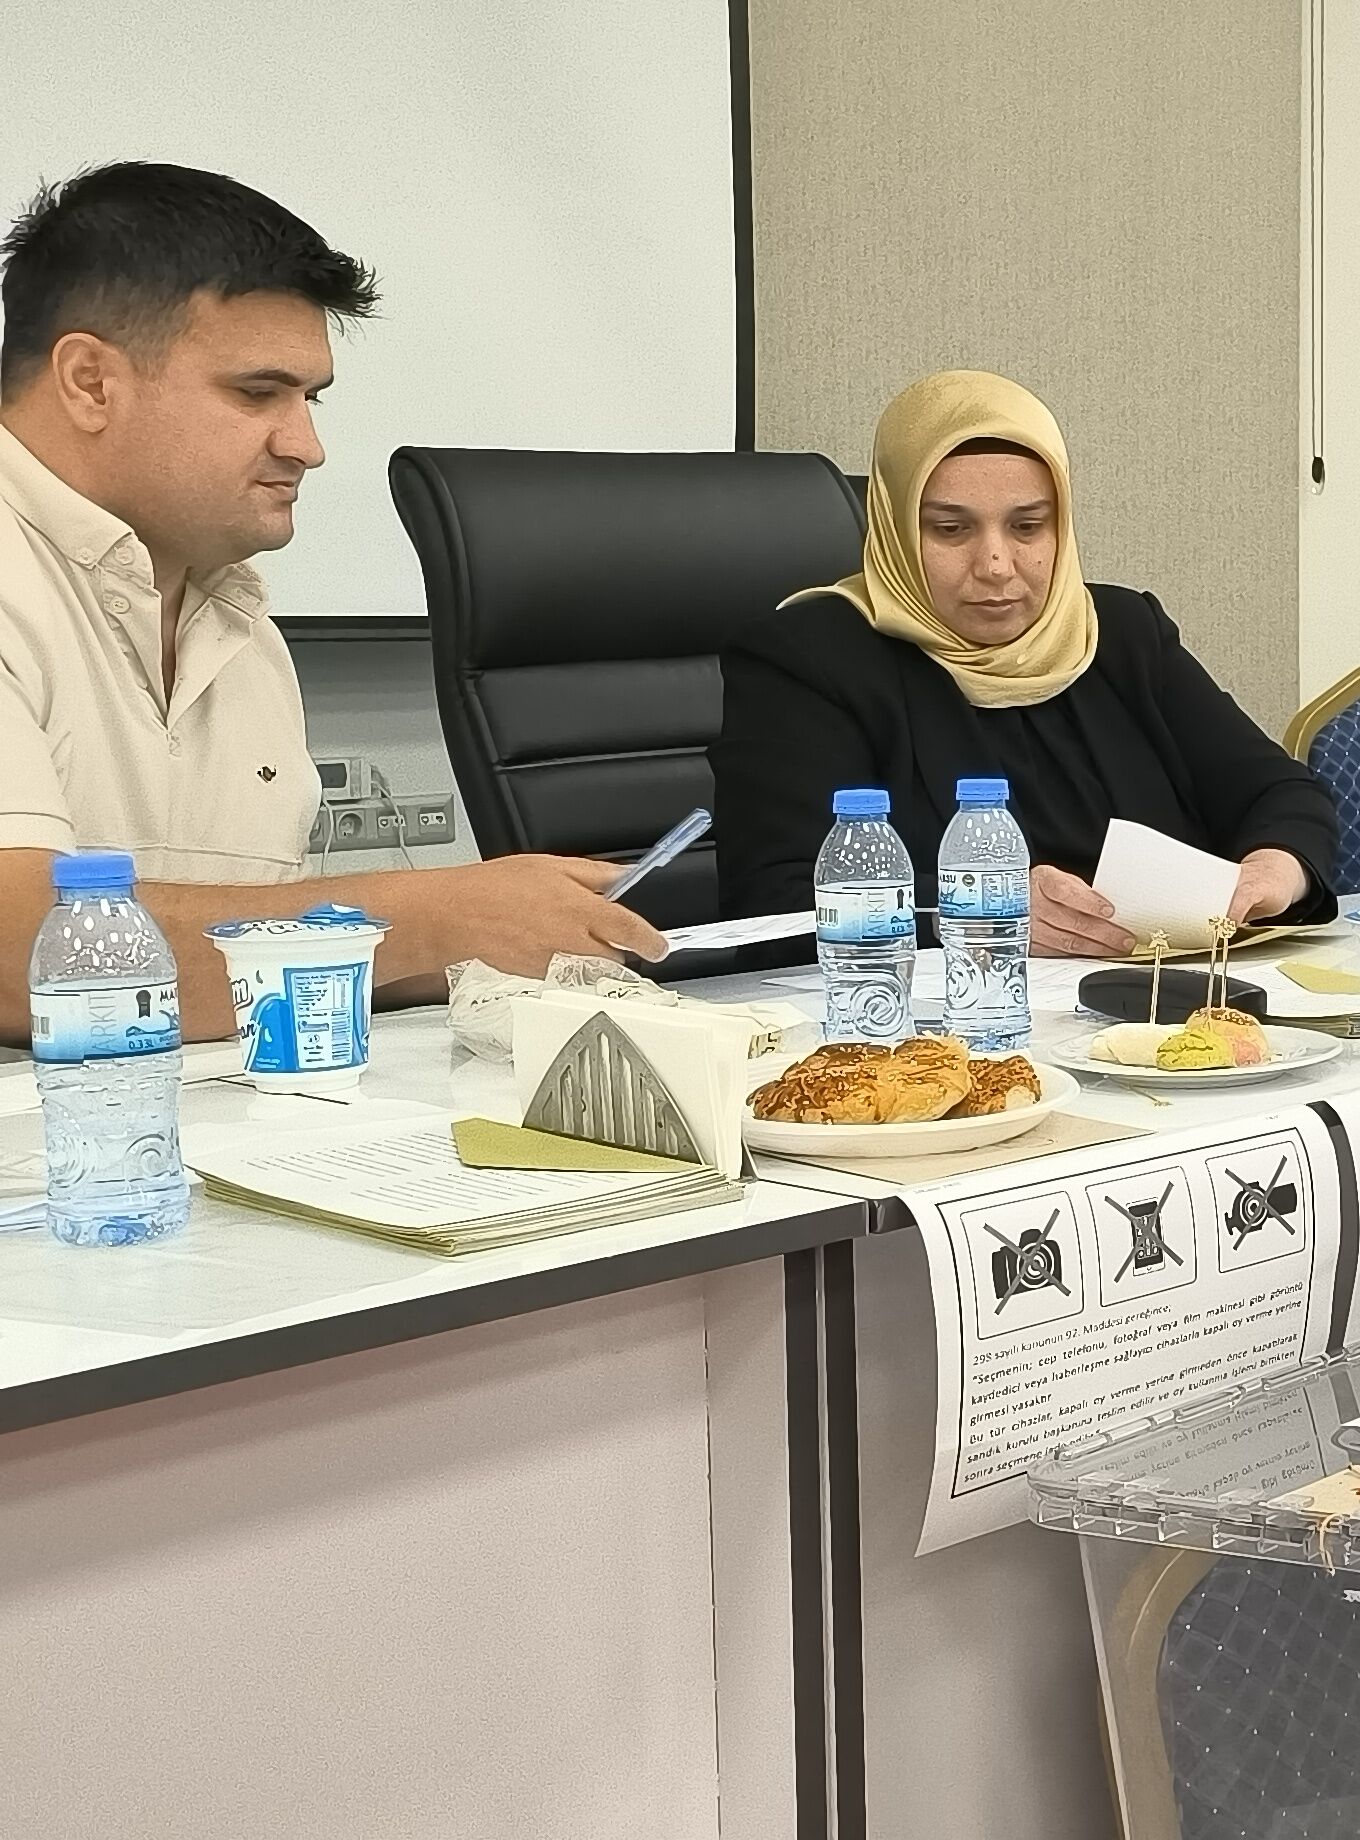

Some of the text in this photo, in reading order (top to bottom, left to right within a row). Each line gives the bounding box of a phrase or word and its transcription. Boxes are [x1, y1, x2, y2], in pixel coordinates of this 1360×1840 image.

[1038, 1355, 1057, 1367] cep
[1157, 1320, 1178, 1333] veya
[1183, 1312, 1201, 1325] film
[971, 1382, 1021, 1406] kaydedici
[1024, 1376, 1048, 1389] veya
[1232, 1318, 1244, 1328] oy
[1173, 1386, 1185, 1397] oy
[970, 1404, 1010, 1427] girmesi
[989, 1426, 1007, 1438] tür
[1093, 1395, 1106, 1405] oy
